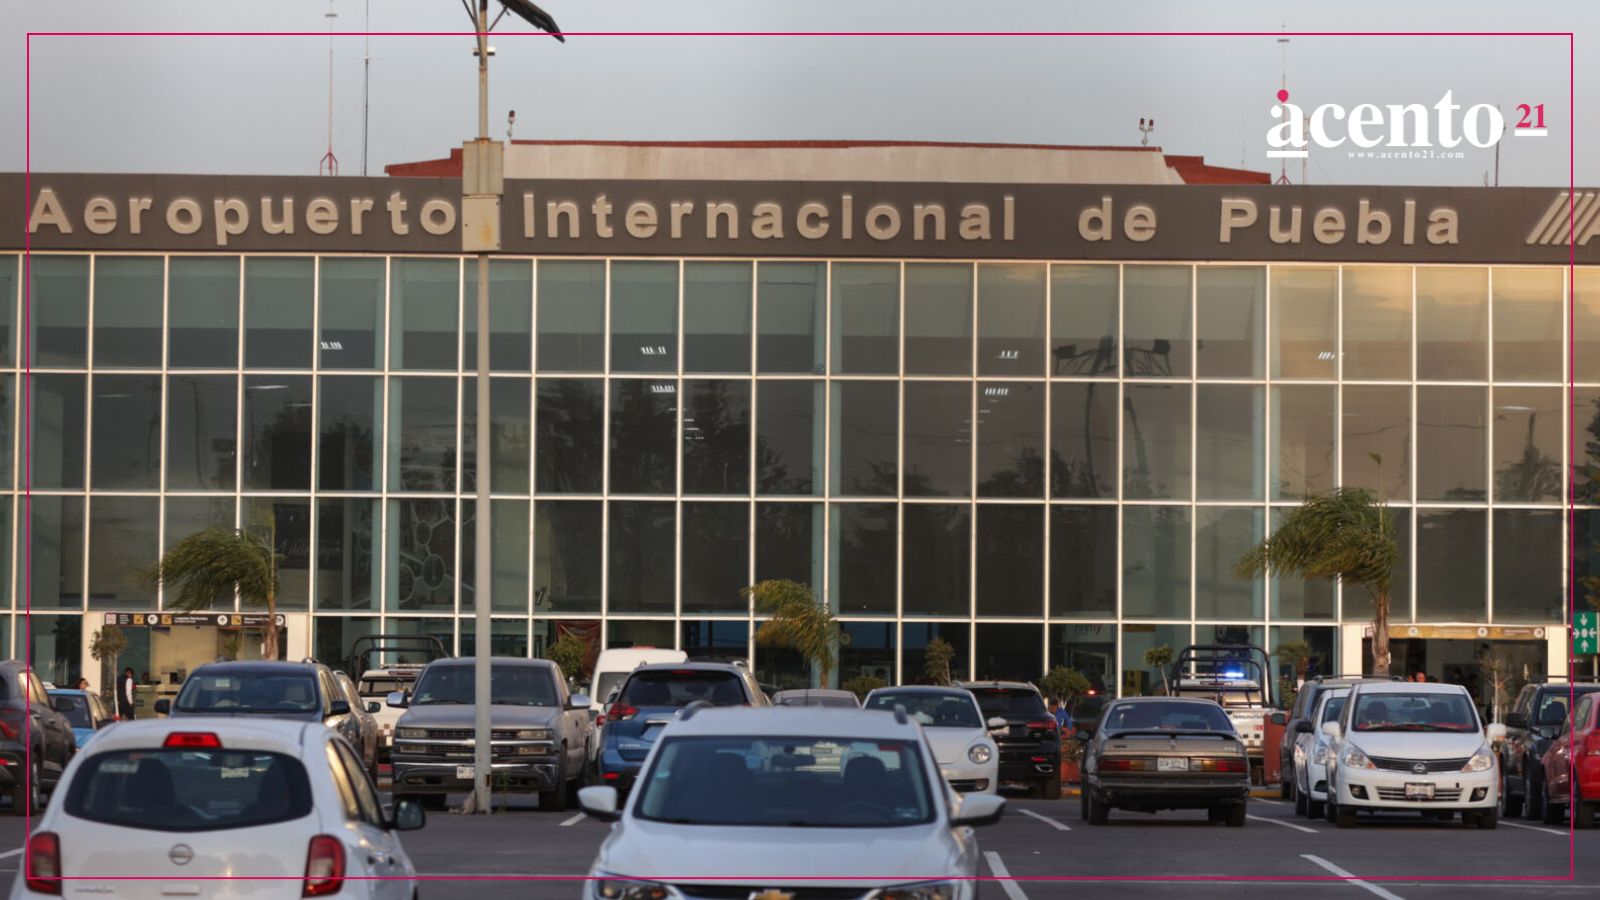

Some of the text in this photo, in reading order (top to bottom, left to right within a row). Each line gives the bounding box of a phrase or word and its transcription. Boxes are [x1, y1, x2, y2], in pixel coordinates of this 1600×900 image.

[29, 187, 1460, 246] Aeropuerto Internacional de Puebla
